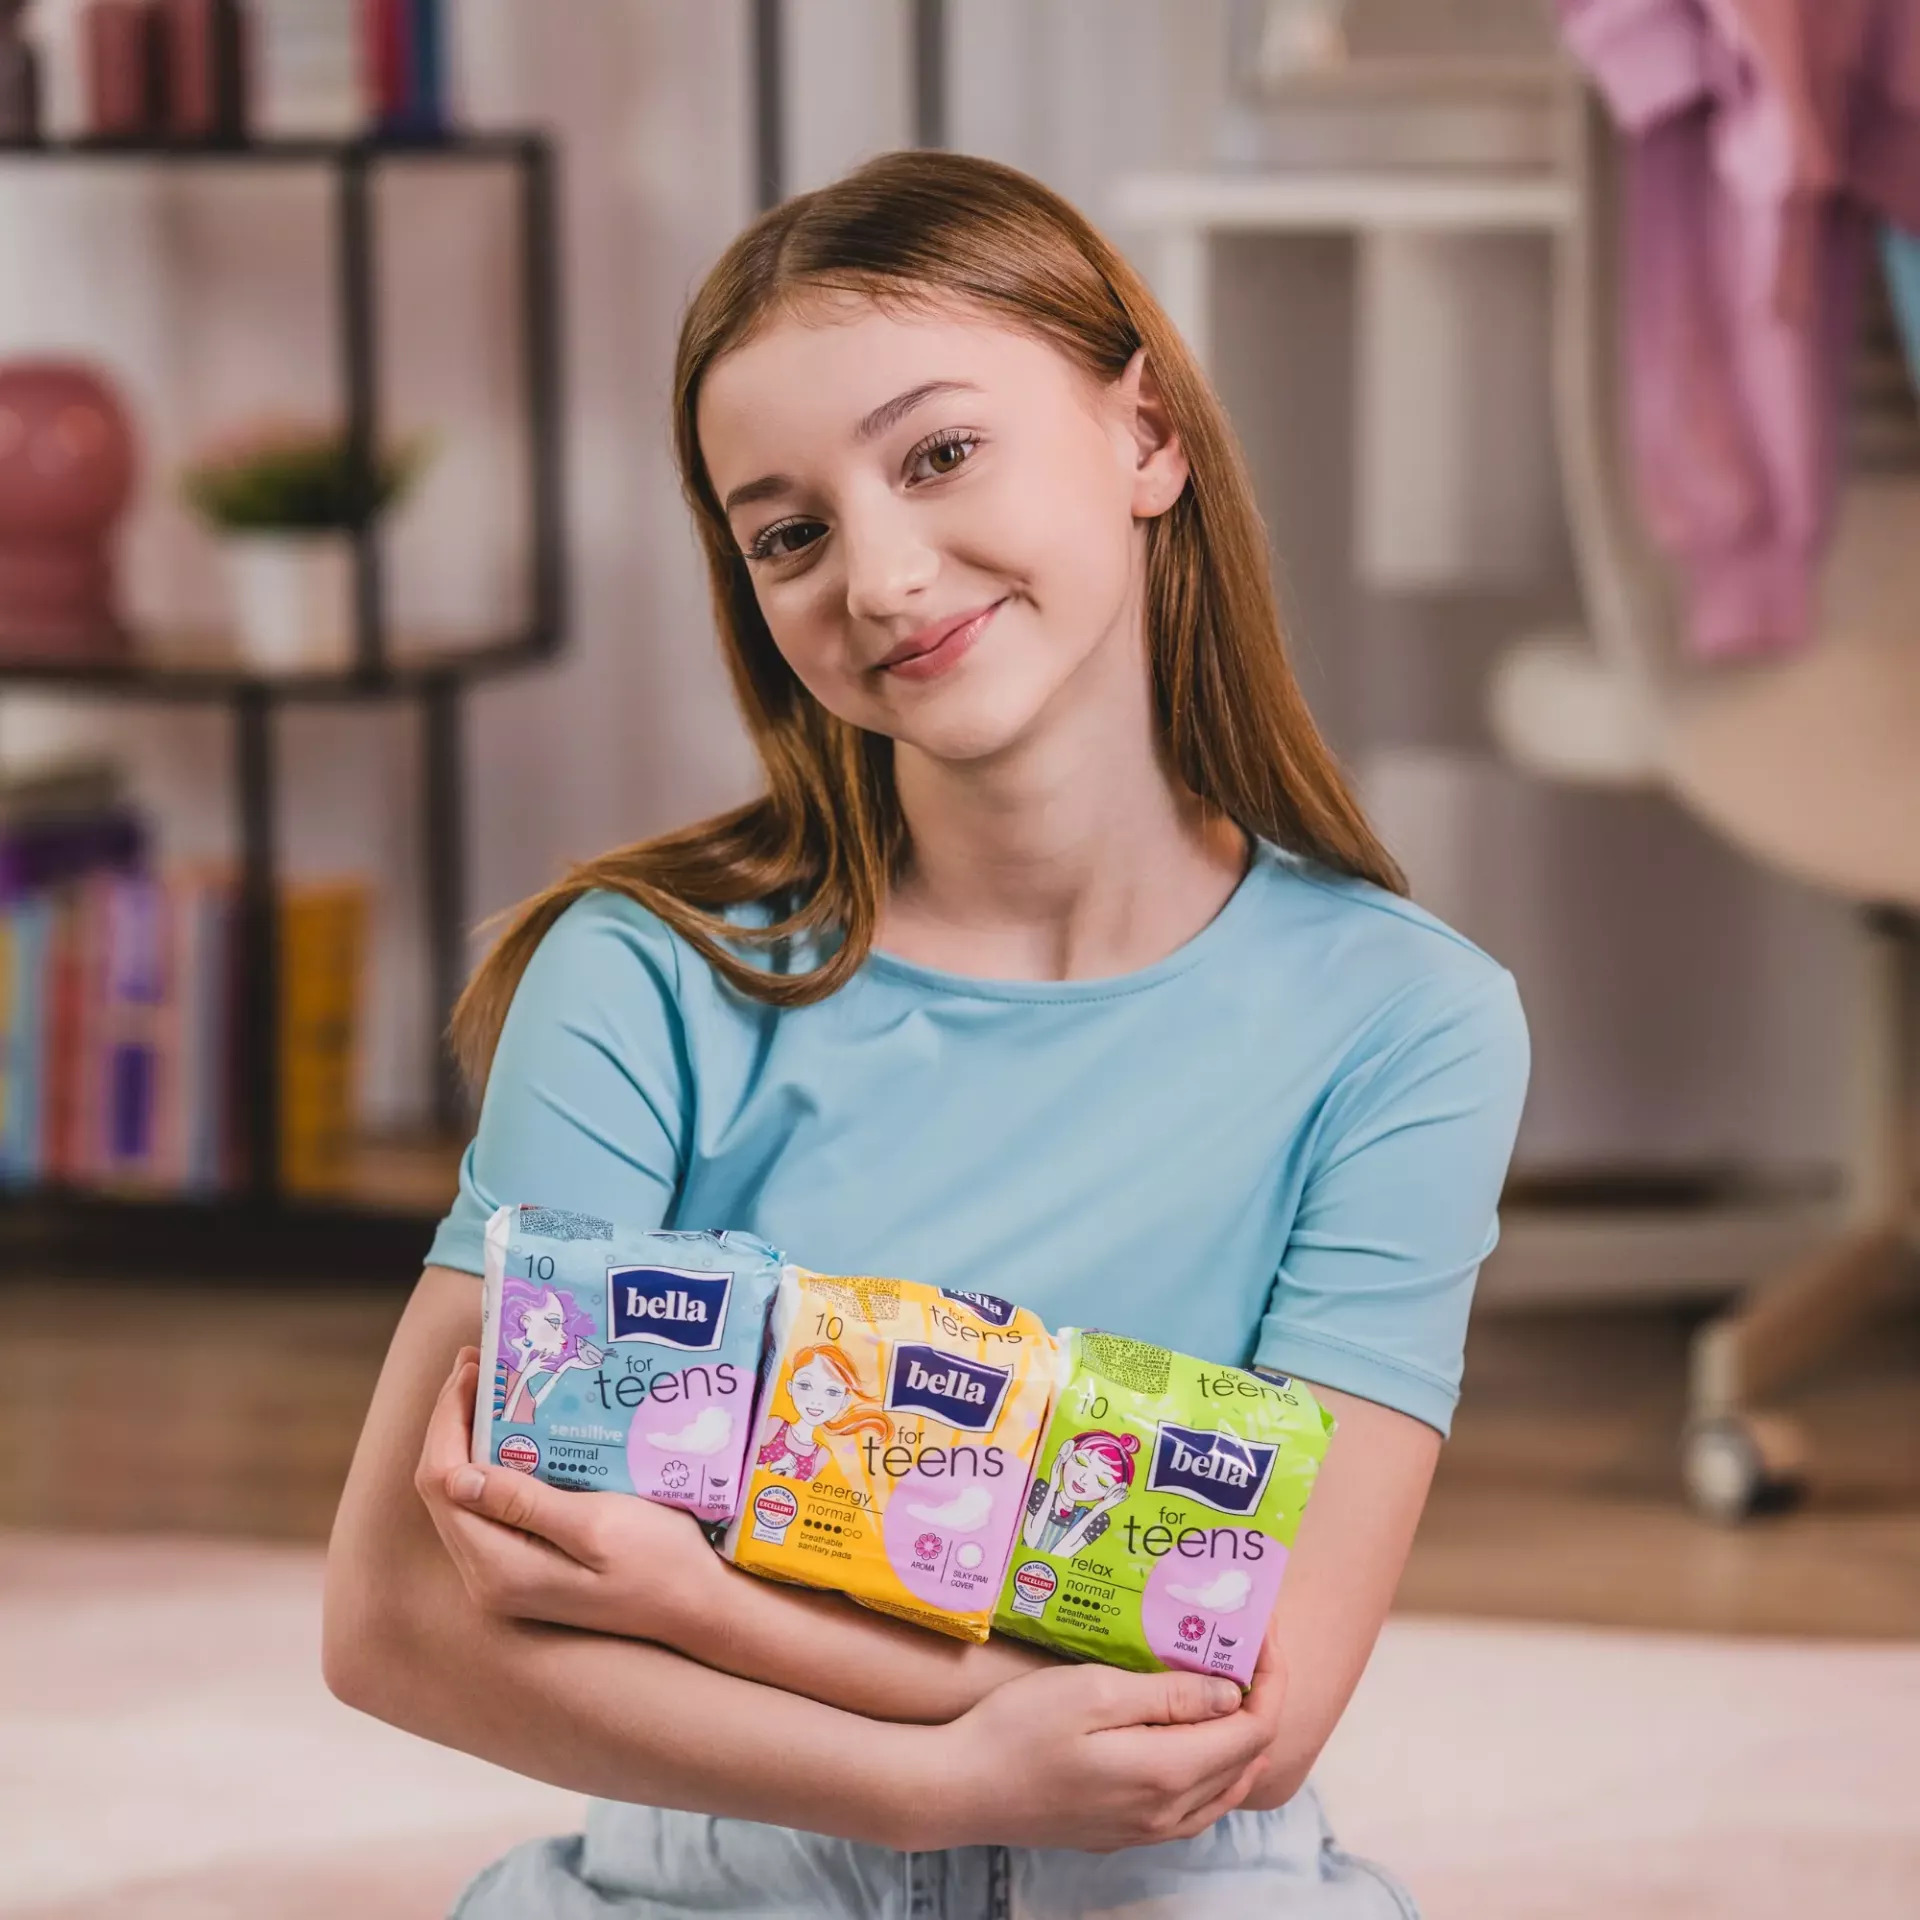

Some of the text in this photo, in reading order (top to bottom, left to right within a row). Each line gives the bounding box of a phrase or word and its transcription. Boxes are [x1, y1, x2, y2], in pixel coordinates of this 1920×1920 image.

[524, 1254, 555, 1280] 10
[626, 1287, 708, 1324] bella
[948, 1307, 964, 1323] for
[815, 1313, 844, 1341] 10
[929, 1305, 1023, 1344] teens
[626, 1355, 653, 1374] for
[906, 1361, 987, 1406] bella
[1222, 1370, 1240, 1381] for
[593, 1363, 738, 1410] teens
[1197, 1373, 1299, 1407] teens
[1081, 1392, 1109, 1419] 10
[550, 1424, 623, 1441] sensitive
[897, 1427, 923, 1444] for
[505, 1437, 533, 1450] ORIGINAL
[502, 1450, 536, 1461] EXCELLENT
[549, 1446, 599, 1460] normal
[863, 1436, 1004, 1478] teens
[1170, 1441, 1249, 1489] bella
[663, 1491, 695, 1500] PERFUME
[763, 1488, 792, 1502] ORIGINAL
[812, 1482, 873, 1507] energy
[759, 1501, 794, 1514] EXCELLENT
[807, 1503, 856, 1523] normal
[1159, 1506, 1186, 1525] for
[800, 1531, 843, 1548] breathable
[1123, 1515, 1265, 1561] teens
[798, 1542, 852, 1560] sanitary pads
[911, 1561, 935, 1572] AROMA
[953, 1570, 972, 1580] SILKY
[1024, 1564, 1052, 1578] ORIGINAL
[1071, 1557, 1114, 1578] relax
[951, 1580, 974, 1590] COVER
[1019, 1575, 1053, 1589] EXCELLENT
[1066, 1579, 1116, 1600] normal
[1058, 1606, 1101, 1623] breathable
[1056, 1615, 1109, 1635] sanitary pads
[1174, 1641, 1198, 1654] AROMA
[1213, 1652, 1231, 1661] SOFT
[1211, 1660, 1234, 1671] COVER
